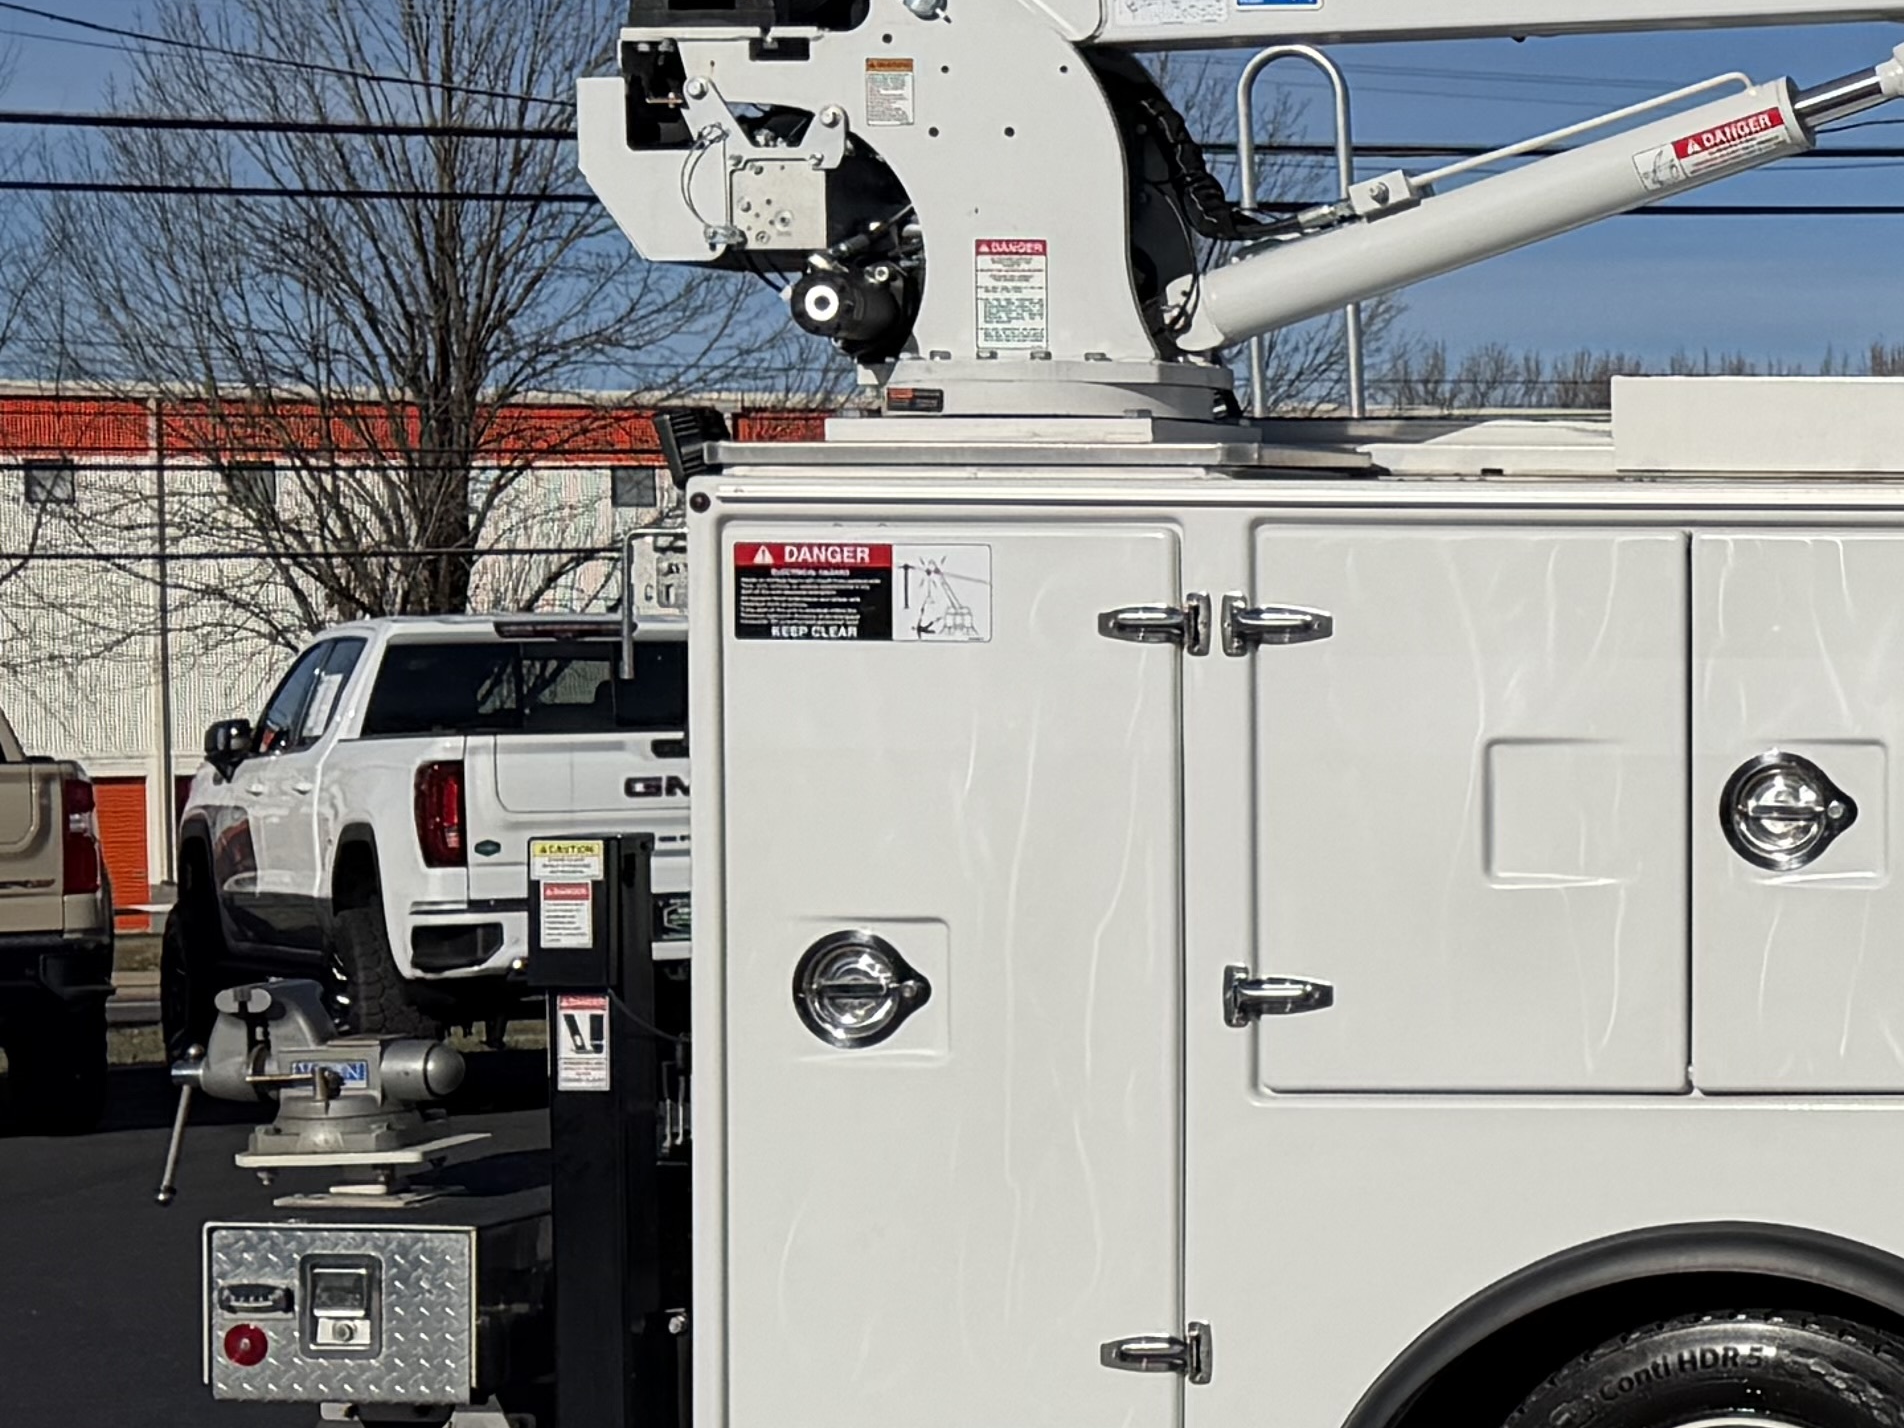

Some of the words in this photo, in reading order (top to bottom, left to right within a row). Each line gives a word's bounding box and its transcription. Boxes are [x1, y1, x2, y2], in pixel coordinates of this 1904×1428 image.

[1701, 113, 1772, 147] DANGER
[991, 241, 1043, 253] DANGER
[783, 545, 870, 563] DANGER
[771, 625, 808, 637] KEEP
[811, 625, 858, 638] CLEAR
[548, 844, 594, 854] CAUTION
[1600, 1354, 1672, 1401] Conti
[1676, 1346, 1741, 1373] HDR
